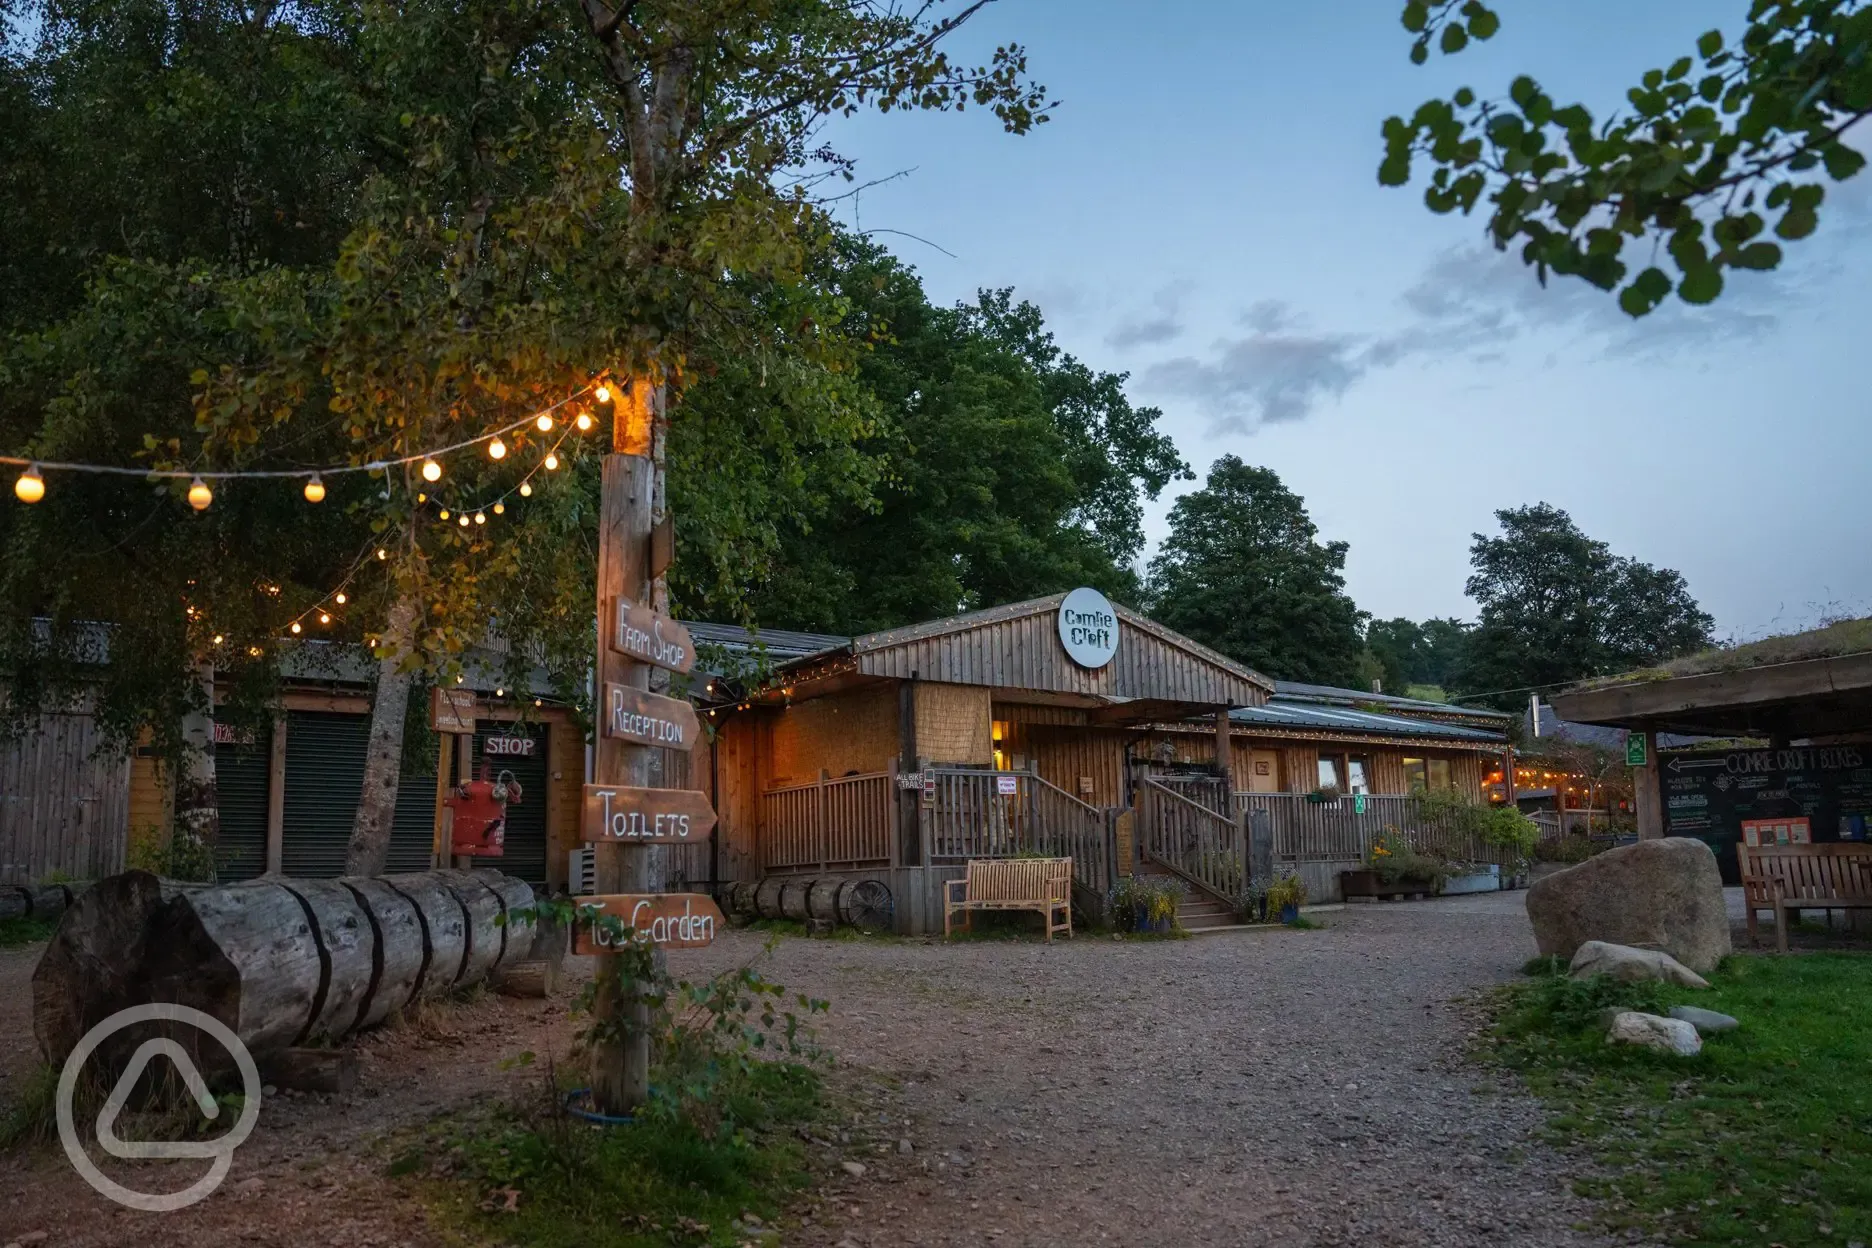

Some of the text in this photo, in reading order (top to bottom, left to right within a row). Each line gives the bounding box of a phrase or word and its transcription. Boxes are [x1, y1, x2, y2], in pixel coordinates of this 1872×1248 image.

[1064, 609, 1113, 628] Comrie
[620, 604, 685, 666] FARM SHOP
[1070, 627, 1111, 650] Croft
[612, 689, 684, 743] RECEPTION
[486, 737, 535, 755] SHOP
[1726, 747, 1864, 774] COMRIE CROFT BIKES
[896, 772, 924, 781] ALL BIKE
[901, 780, 924, 789] TRAILS
[596, 791, 690, 837] TOILETS
[631, 899, 714, 944] Garden
